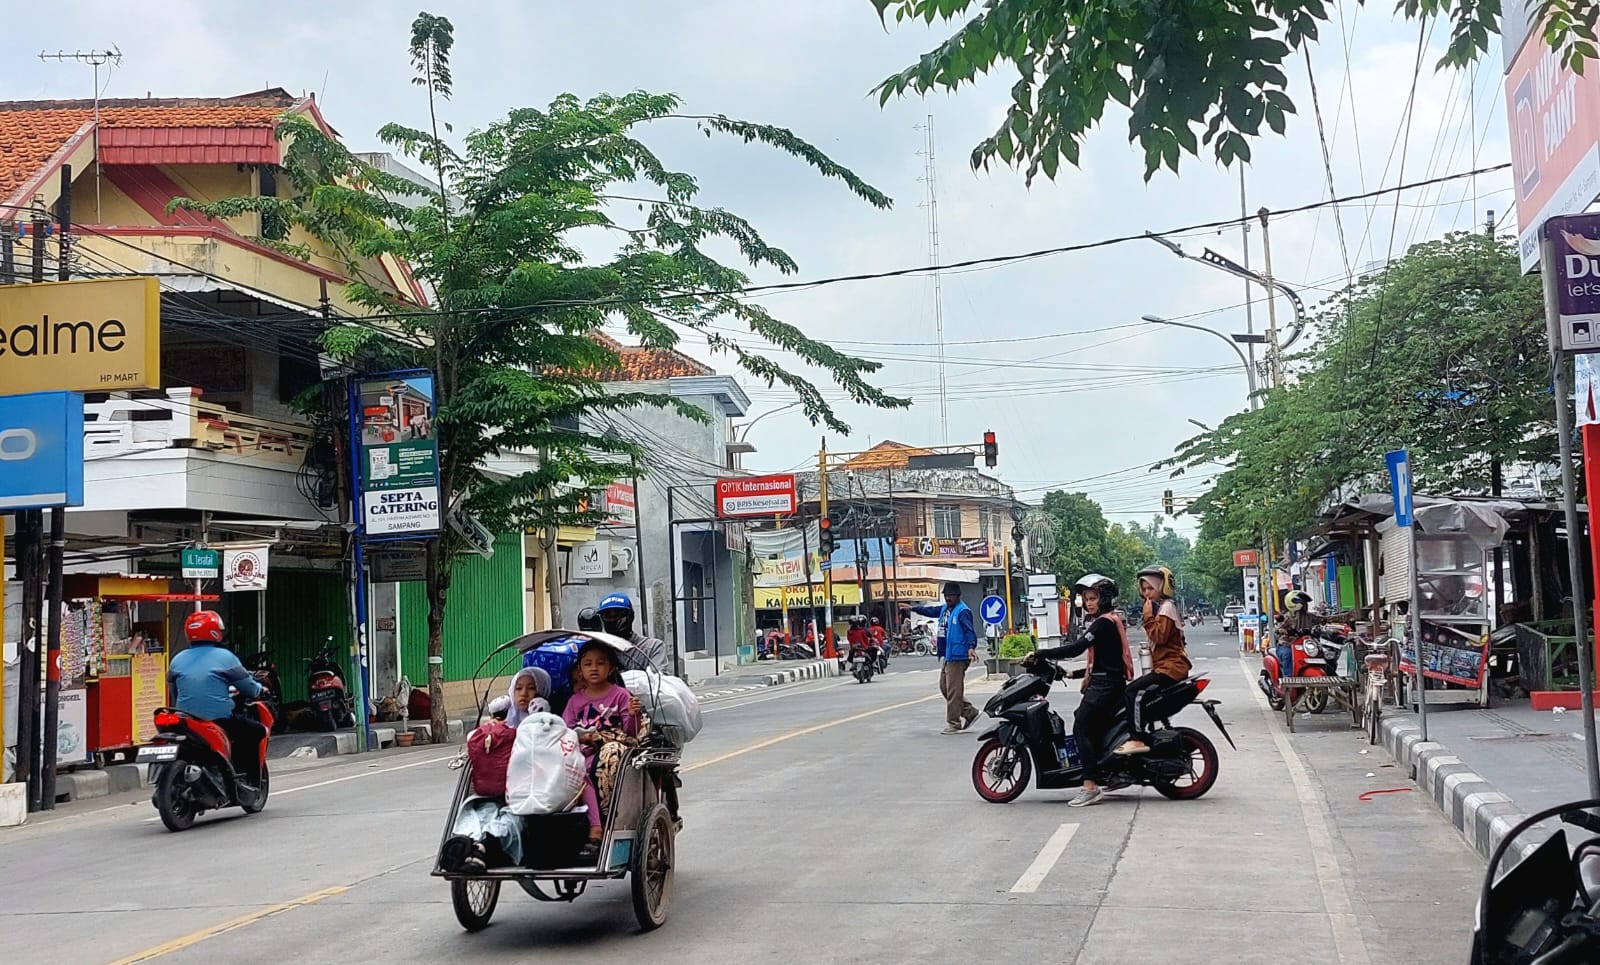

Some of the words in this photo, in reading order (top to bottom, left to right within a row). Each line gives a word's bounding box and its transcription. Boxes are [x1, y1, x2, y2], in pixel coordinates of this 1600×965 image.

[1543, 73, 1577, 162] PAINT
[0, 315, 126, 357] alme
[100, 374, 112, 382] HP
[114, 373, 139, 382] MART
[721, 481, 742, 493] OPTIK
[742, 478, 792, 491] Internasional
[380, 491, 423, 503] SEPTA
[370, 501, 437, 515] CATERING
[388, 521, 421, 530] SAMPANG
[921, 538, 932, 555] 76
[782, 585, 806, 594] OKO
[766, 596, 811, 607] KAANG
